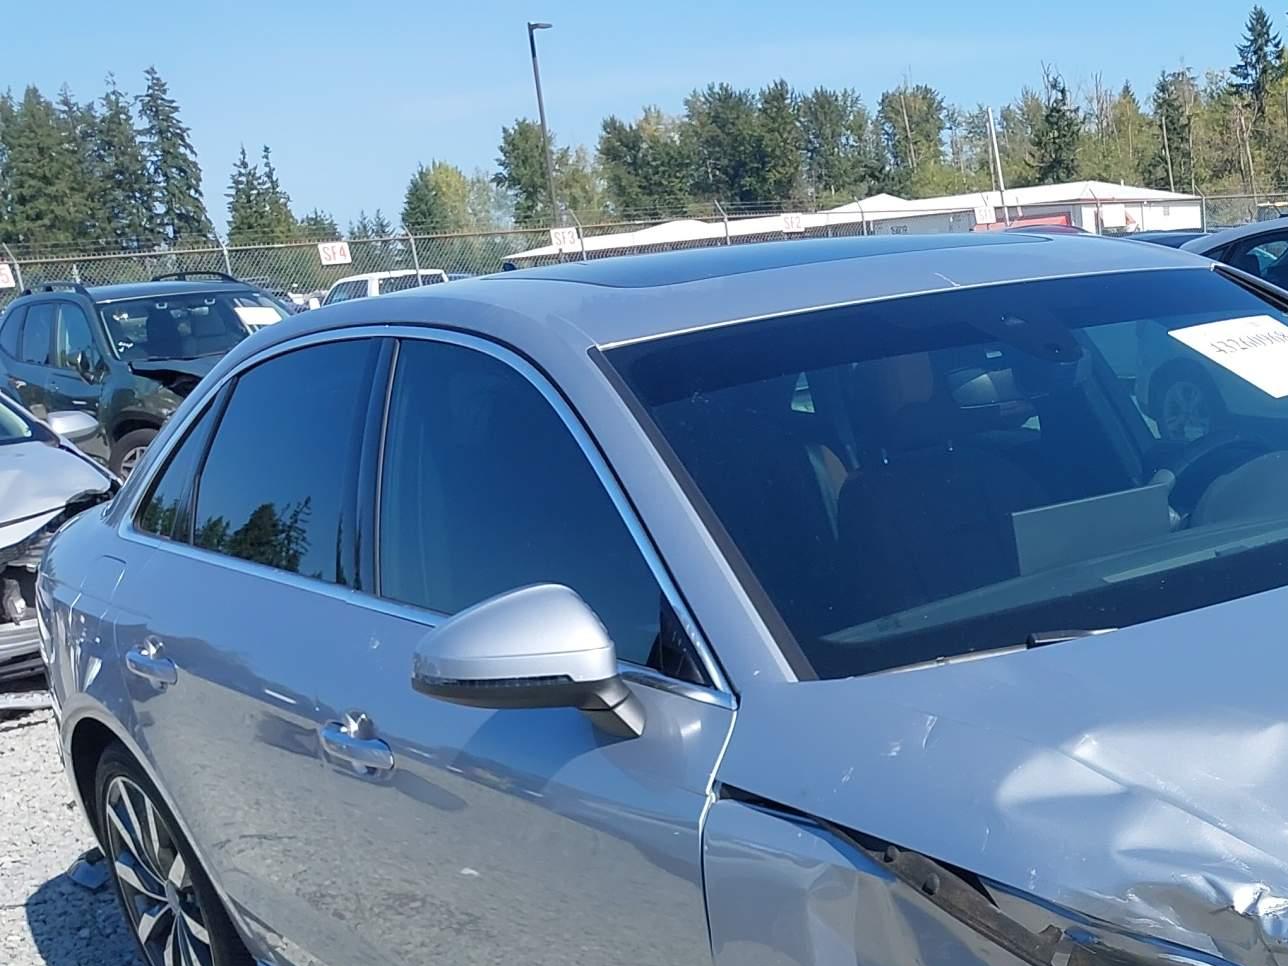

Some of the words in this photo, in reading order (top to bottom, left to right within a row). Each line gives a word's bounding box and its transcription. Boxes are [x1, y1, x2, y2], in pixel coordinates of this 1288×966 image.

[783, 215, 802, 230] SF2
[554, 230, 576, 246] SF3
[322, 244, 347, 262] SF4
